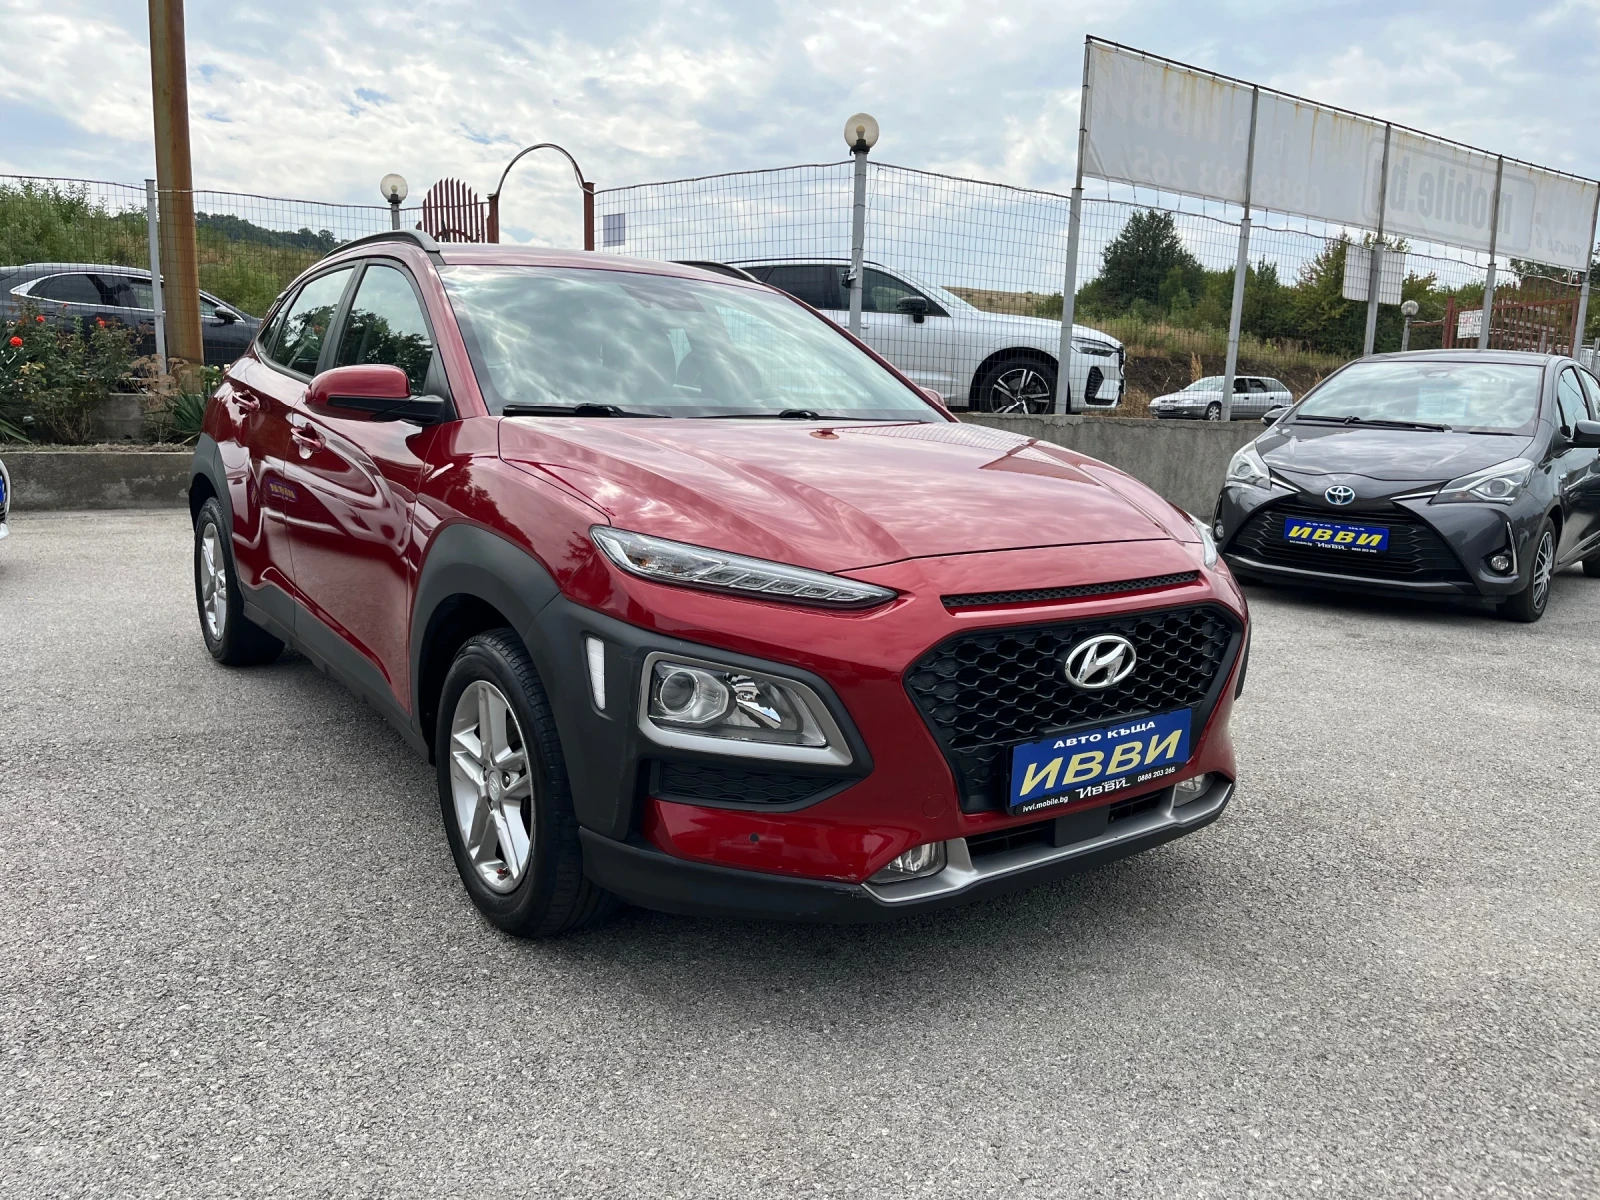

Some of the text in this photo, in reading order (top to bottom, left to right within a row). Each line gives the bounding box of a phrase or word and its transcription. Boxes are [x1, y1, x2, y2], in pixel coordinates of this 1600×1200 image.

[1288, 525, 1383, 547] ИВВИ
[1053, 721, 1156, 749] АВТО КЪЩА
[1019, 729, 1183, 797] ИВВИ
